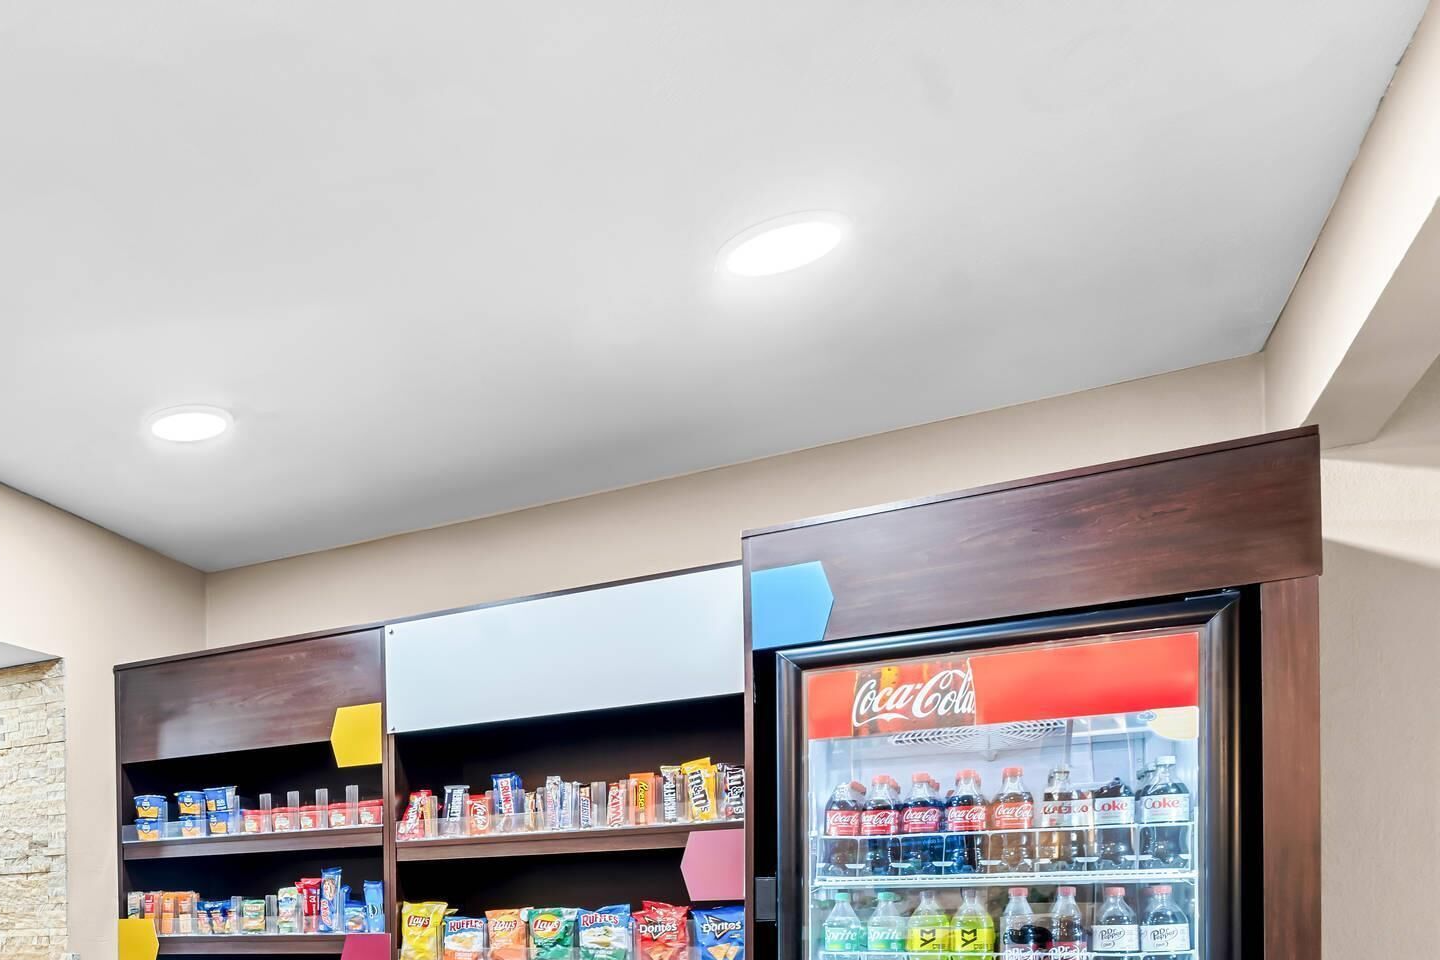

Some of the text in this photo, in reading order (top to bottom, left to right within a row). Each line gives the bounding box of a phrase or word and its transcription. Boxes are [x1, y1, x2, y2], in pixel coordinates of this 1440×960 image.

[853, 660, 976, 727] Coca-Cola
[499, 779, 513, 816] CRUNCH
[1143, 797, 1180, 810] Coke
[1093, 799, 1129, 812] Coke
[861, 810, 895, 825] oca-Cola
[449, 919, 484, 932] RUFFLES
[581, 914, 619, 927] RUFFLES
[825, 928, 858, 941] Sprite
[868, 928, 902, 941] Sprite
